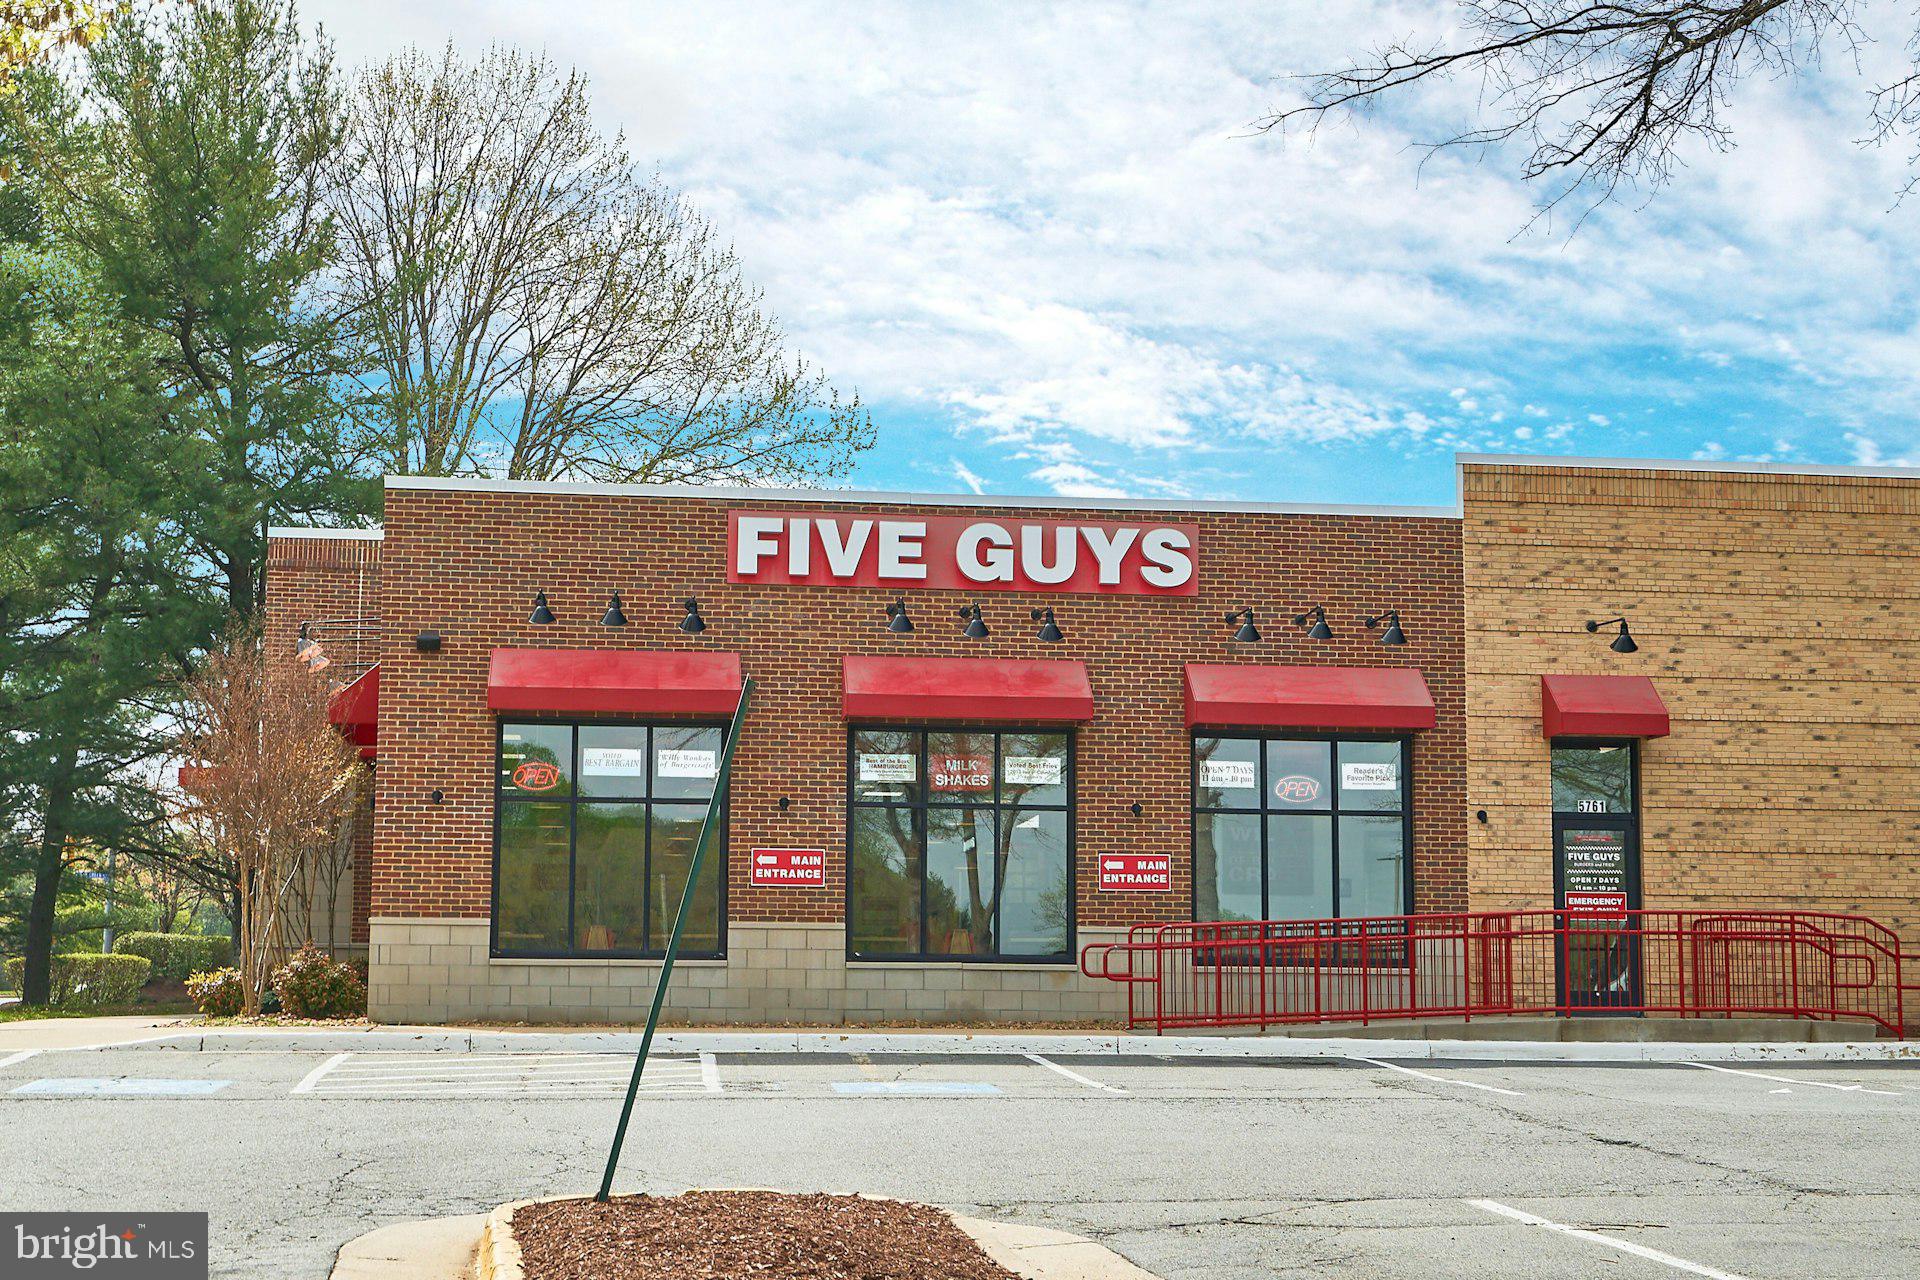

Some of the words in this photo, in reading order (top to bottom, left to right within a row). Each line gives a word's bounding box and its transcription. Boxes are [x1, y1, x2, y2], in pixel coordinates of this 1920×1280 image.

[736, 516, 927, 579] FIVE
[956, 522, 1193, 588] GUYS
[585, 759, 602, 767] BEST
[605, 759, 640, 768] BARGAIN
[945, 759, 978, 771] MILK
[1201, 765, 1224, 774] OPEN
[1225, 765, 1231, 774] 7
[1232, 765, 1254, 774] DAYS
[512, 767, 560, 786] OPEN
[935, 774, 989, 786] SHAKES
[1202, 774, 1209, 782] 11
[1240, 776, 1253, 784] pm
[1275, 780, 1320, 799] OPEN
[1578, 800, 1604, 812] 5761
[791, 855, 821, 865] MAIN
[1568, 852, 1590, 861] FIVE
[1592, 852, 1621, 861] GUYS
[1137, 861, 1167, 870] MAIN
[755, 868, 821, 878] ENTRANCE
[1103, 874, 1167, 883] ENTRANCE
[1568, 897, 1623, 905] EMERGENCY
